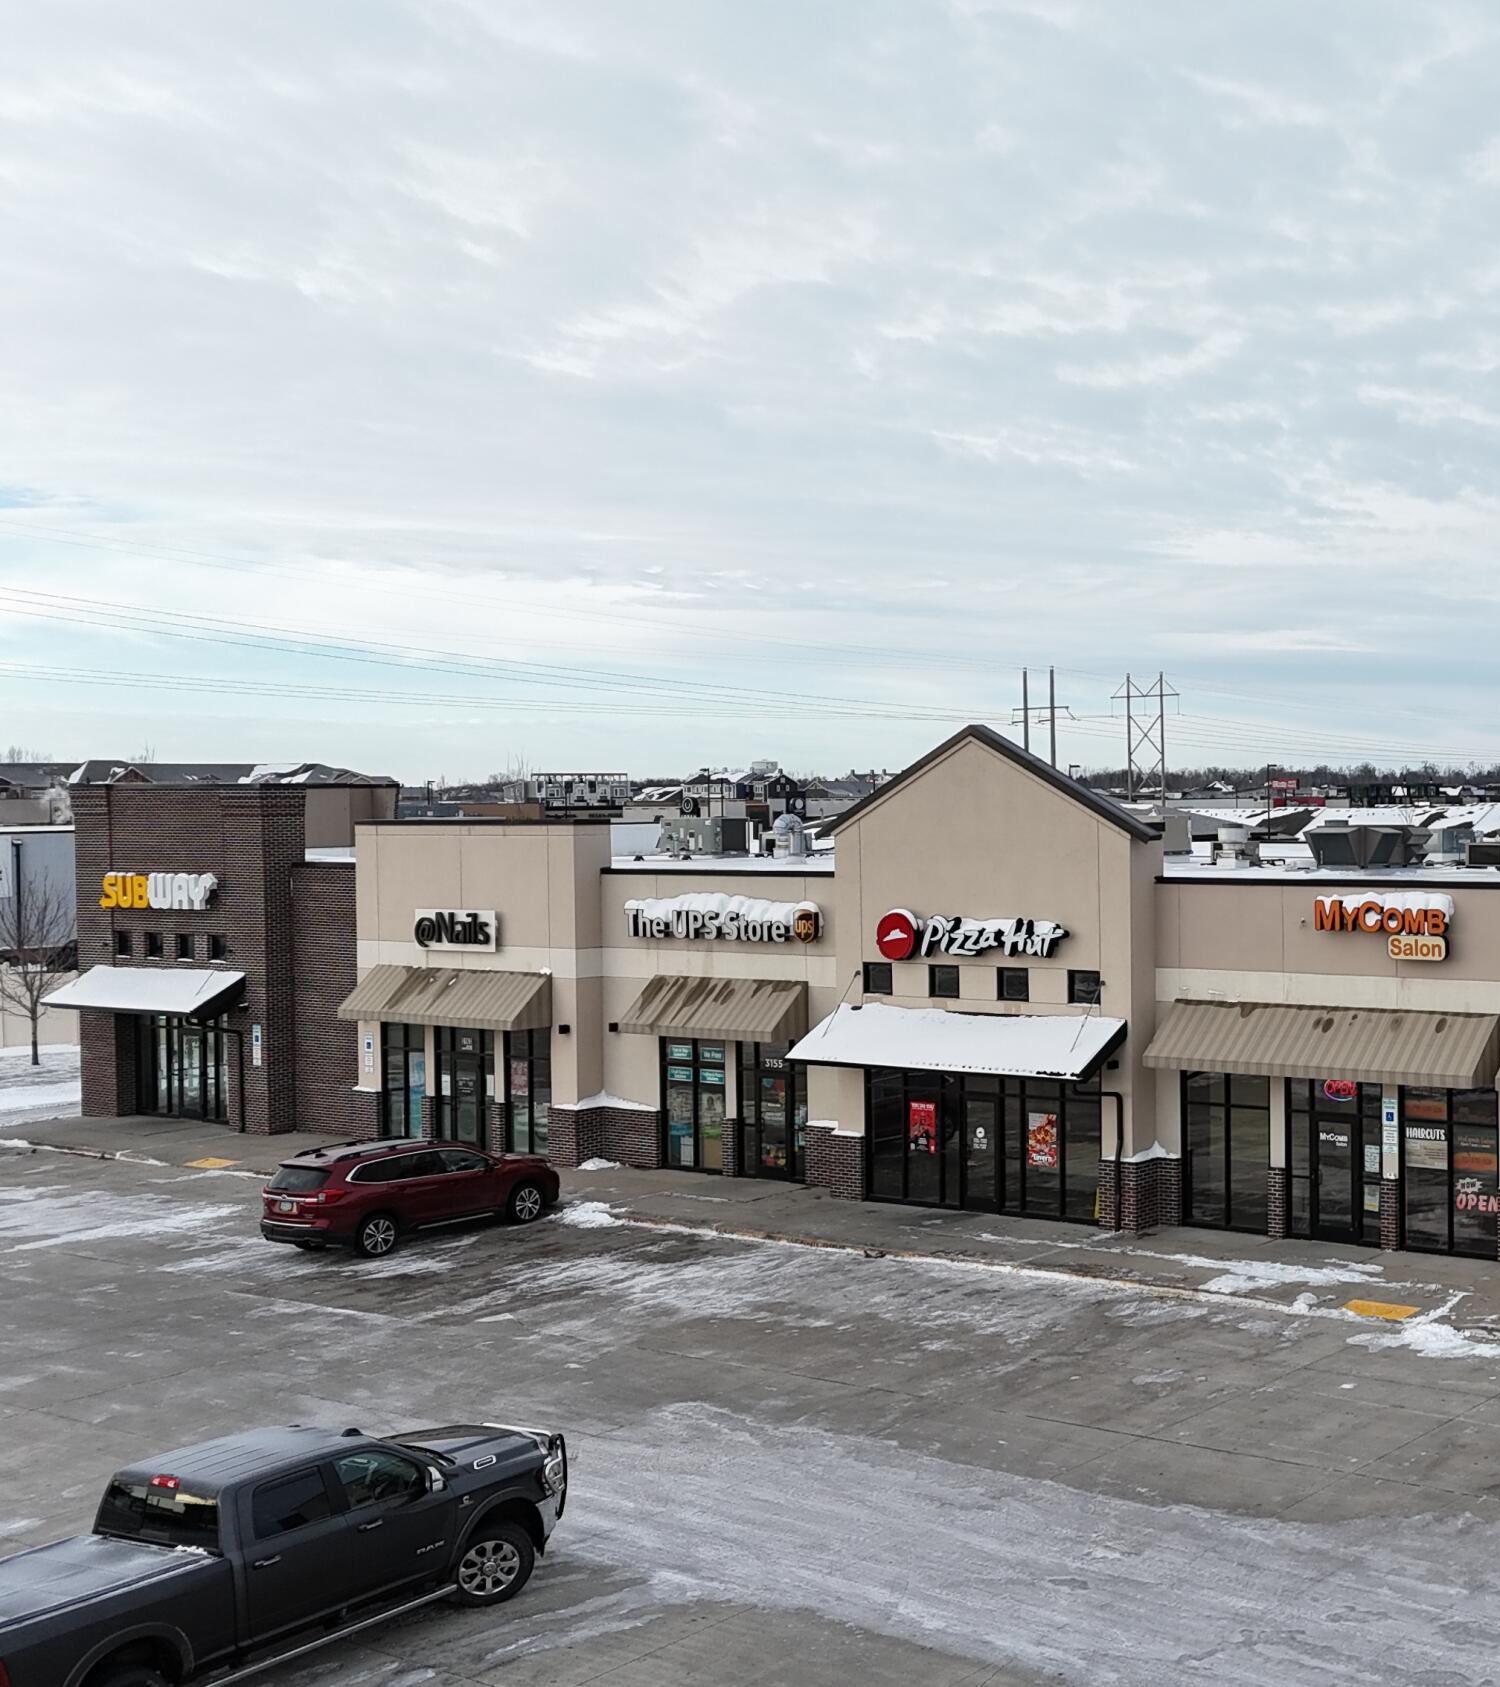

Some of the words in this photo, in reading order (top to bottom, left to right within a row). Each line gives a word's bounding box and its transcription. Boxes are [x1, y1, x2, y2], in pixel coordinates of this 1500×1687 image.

[99, 872, 217, 911] SUBWAY
[414, 911, 491, 948] @Nails
[624, 908, 665, 938] The
[672, 909, 718, 940] UPS
[724, 911, 785, 943] Store
[794, 919, 814, 939] ups
[921, 915, 998, 956] Pizza
[1001, 917, 1067, 958] Hut
[1390, 937, 1442, 958] Salon
[764, 1058, 784, 1069] 3155
[1327, 1080, 1358, 1097] OPEN
[1405, 1127, 1446, 1141] HAIRCUTS
[1455, 1193, 1498, 1213] OPEN
